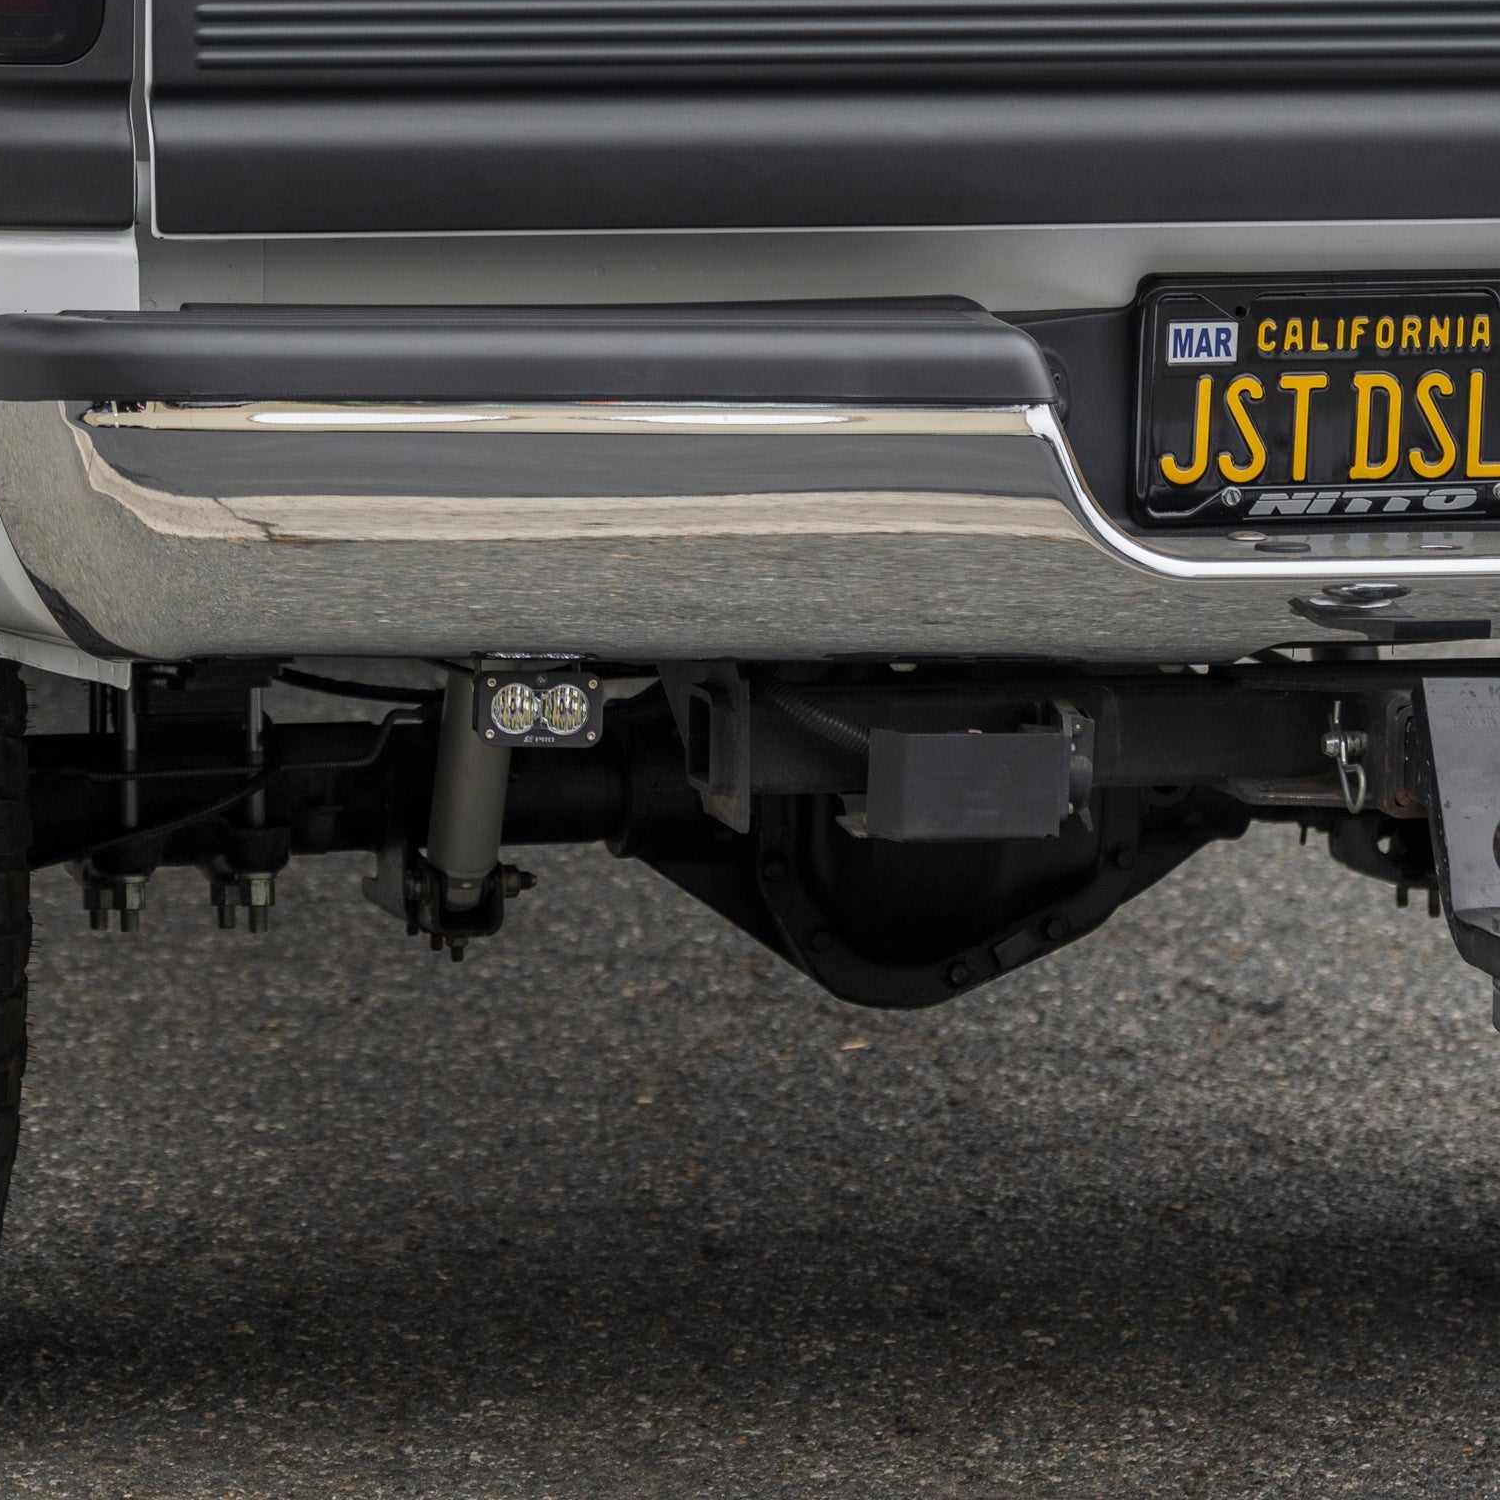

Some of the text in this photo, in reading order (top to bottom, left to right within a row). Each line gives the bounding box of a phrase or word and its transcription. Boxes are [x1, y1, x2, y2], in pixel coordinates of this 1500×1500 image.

[1172, 327, 1233, 360] MAR
[1256, 315, 1492, 352] CALIFORNIA
[1160, 371, 1500, 485] JST DSL
[1248, 487, 1478, 516] NITTO
